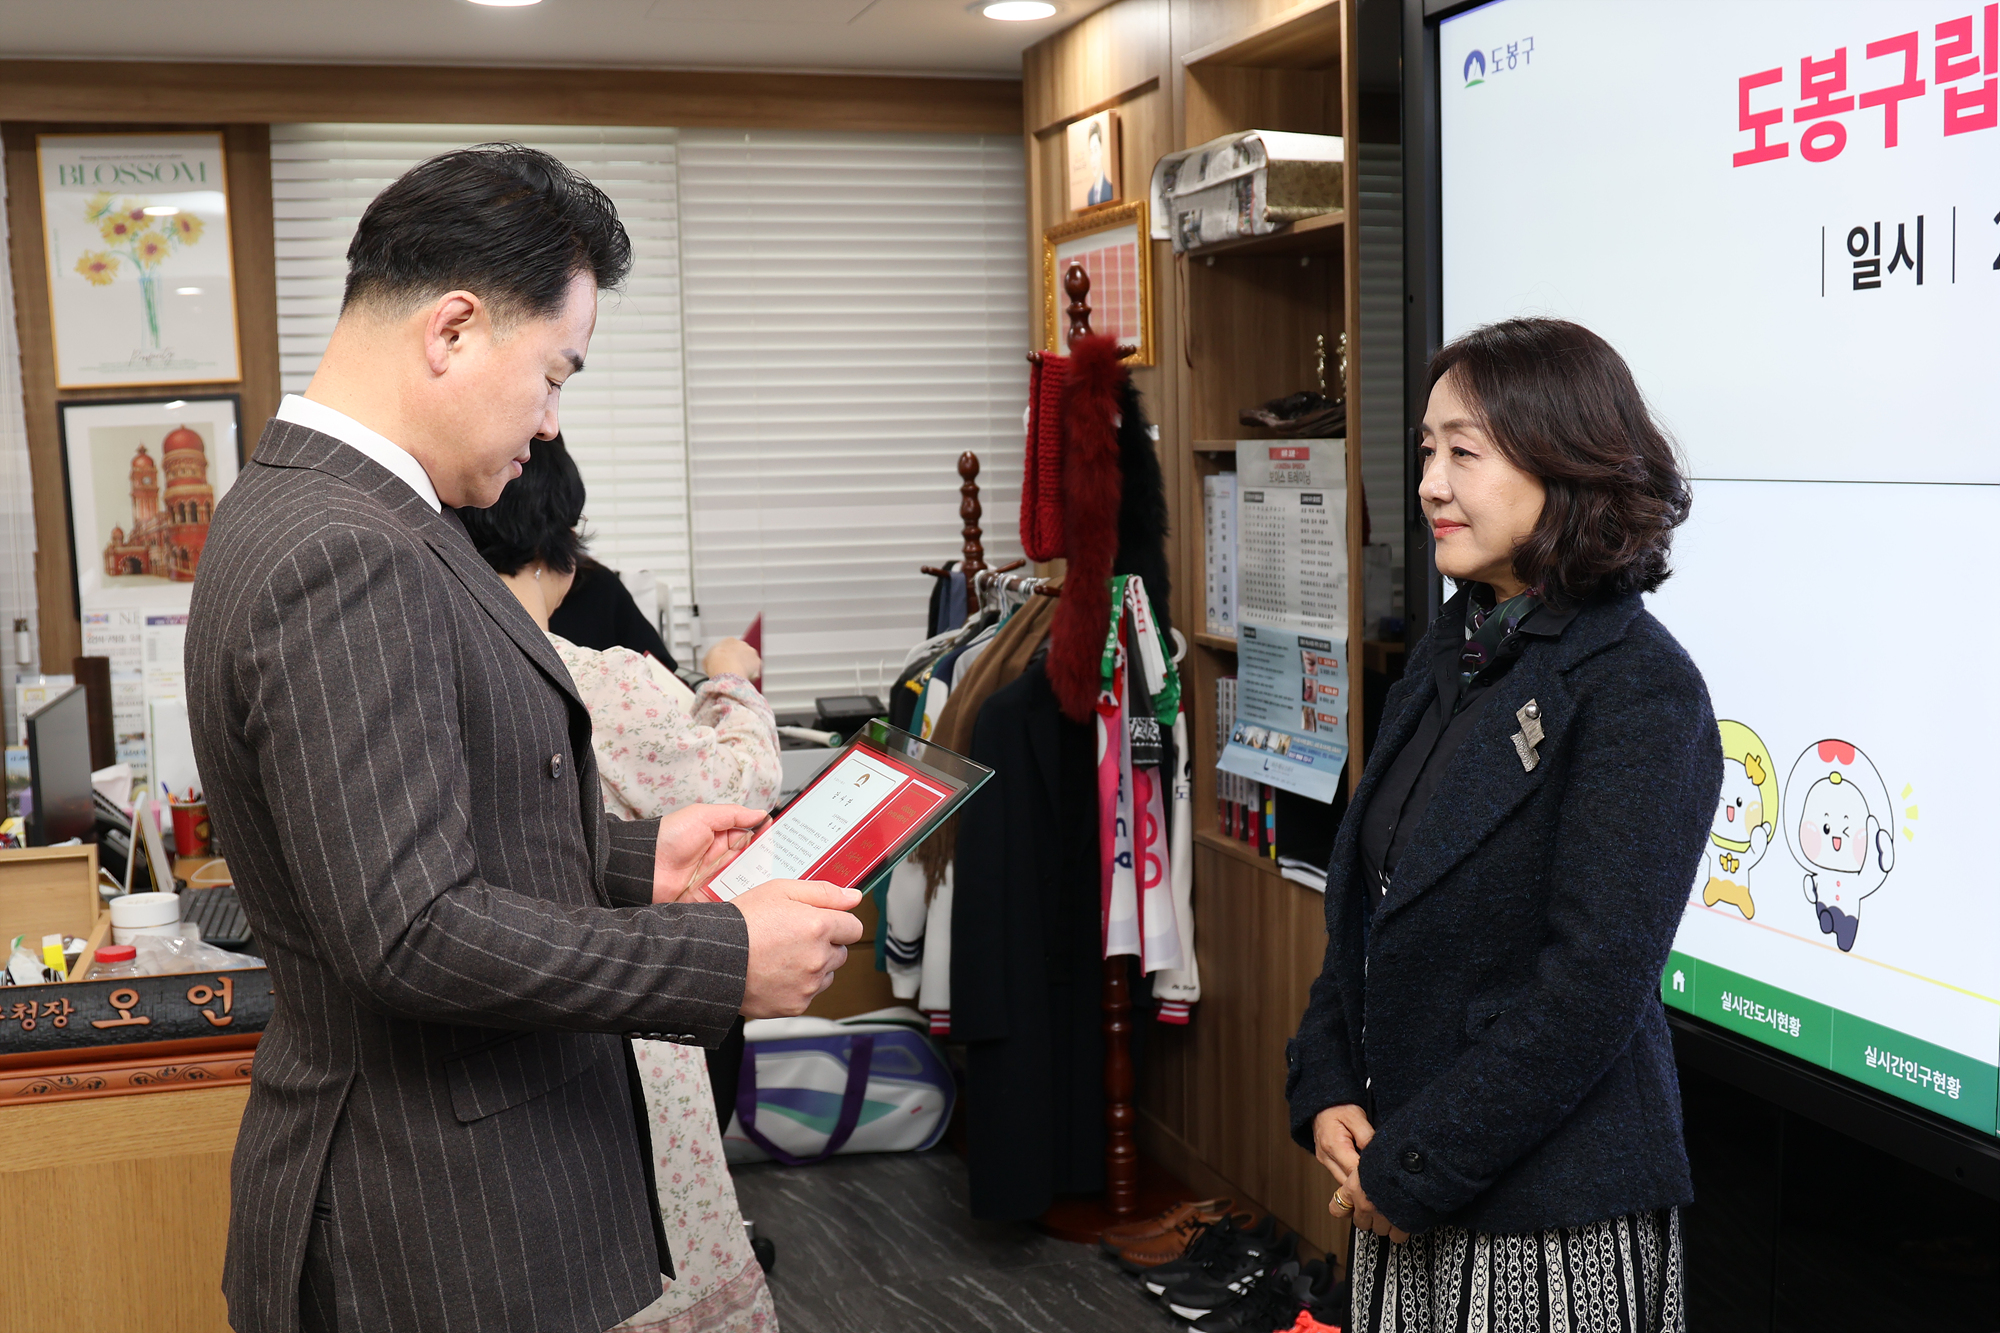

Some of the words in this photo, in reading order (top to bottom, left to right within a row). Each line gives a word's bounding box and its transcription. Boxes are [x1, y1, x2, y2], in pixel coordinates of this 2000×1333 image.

[1491, 36, 1535, 74] 도봉구
[1733, 3, 1999, 168] 도봉구립
[58, 160, 207, 187] BLOSSOM
[1846, 214, 1924, 291] 일시
[0, 997, 75, 1031] 청장
[91, 988, 151, 1029] 오
[186, 976, 234, 1027] 언
[1720, 990, 1802, 1038] 실시간도시현황
[1864, 1045, 1962, 1100] 실시간인구현황
